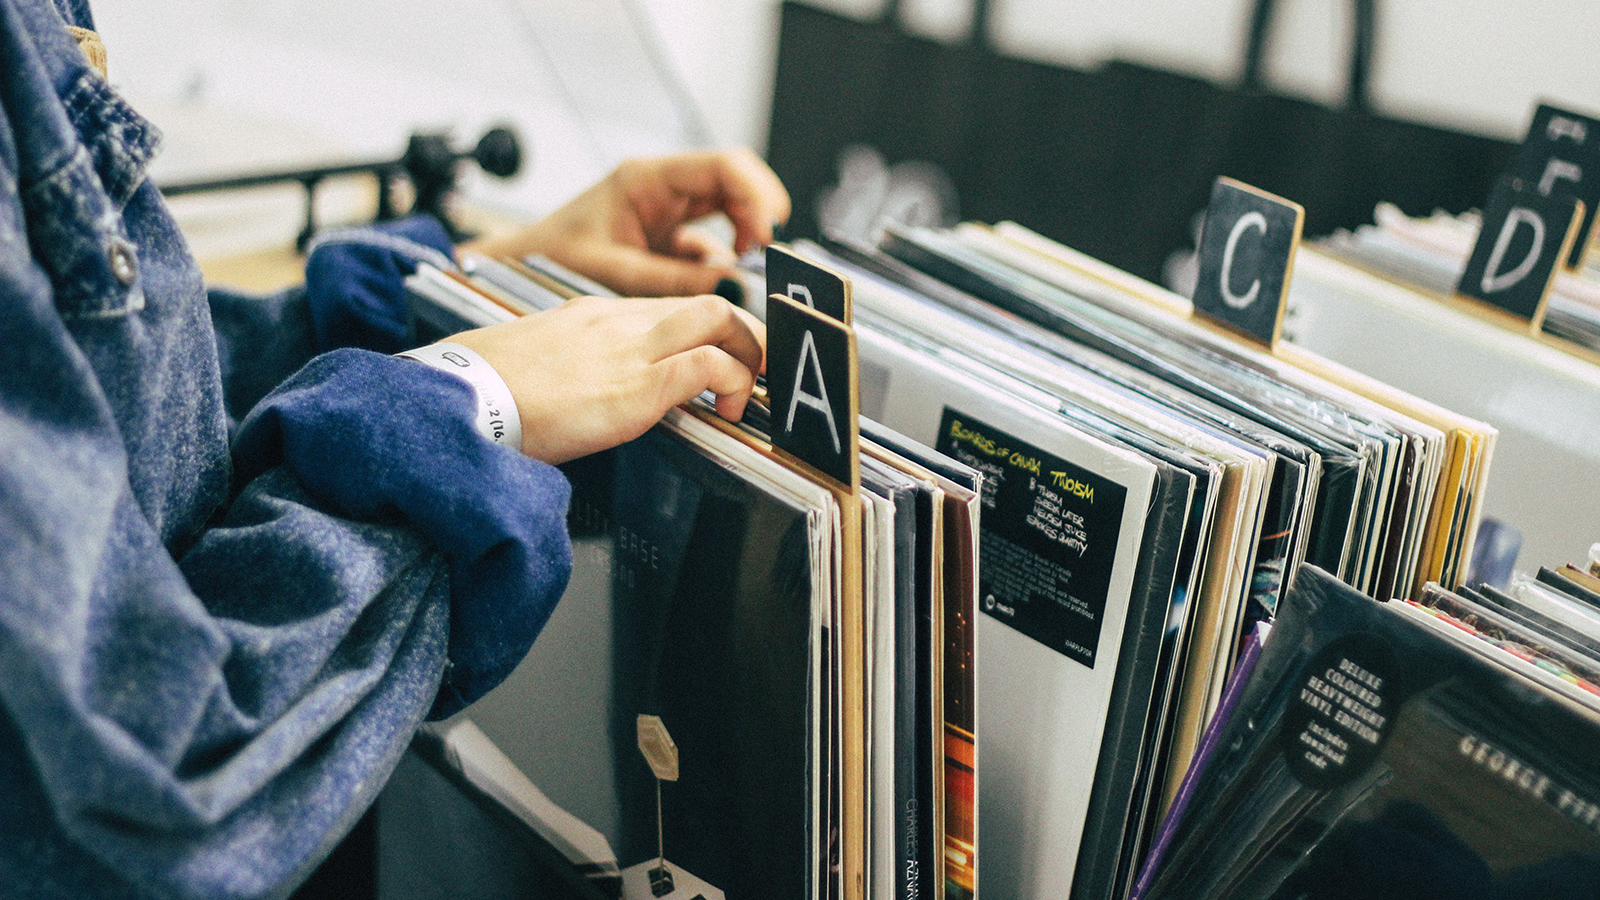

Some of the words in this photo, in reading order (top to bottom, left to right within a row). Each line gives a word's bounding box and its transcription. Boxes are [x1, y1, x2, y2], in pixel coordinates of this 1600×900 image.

[1220, 211, 1268, 309] C
[1481, 207, 1545, 294] D
[489, 409, 501, 418] 2
[784, 329, 841, 454] A
[951, 420, 996, 455] BOARDS
[997, 445, 1010, 459] OF
[1050, 470, 1095, 504] TWOISM
[1029, 477, 1036, 491] B
[1062, 509, 1085, 529] LATER
[1065, 523, 1087, 542] JUICE
[1325, 668, 1382, 708] COLOURED
[1339, 658, 1383, 690] DELUXE
[1301, 688, 1333, 716] VINYL
[1334, 709, 1380, 744] EDITION
[1307, 675, 1386, 728] HEAVYWEIGHT
[1458, 733, 1551, 798] GEORGE
[1558, 789, 1600, 832] FIT
[905, 798, 919, 857] CHARLES
